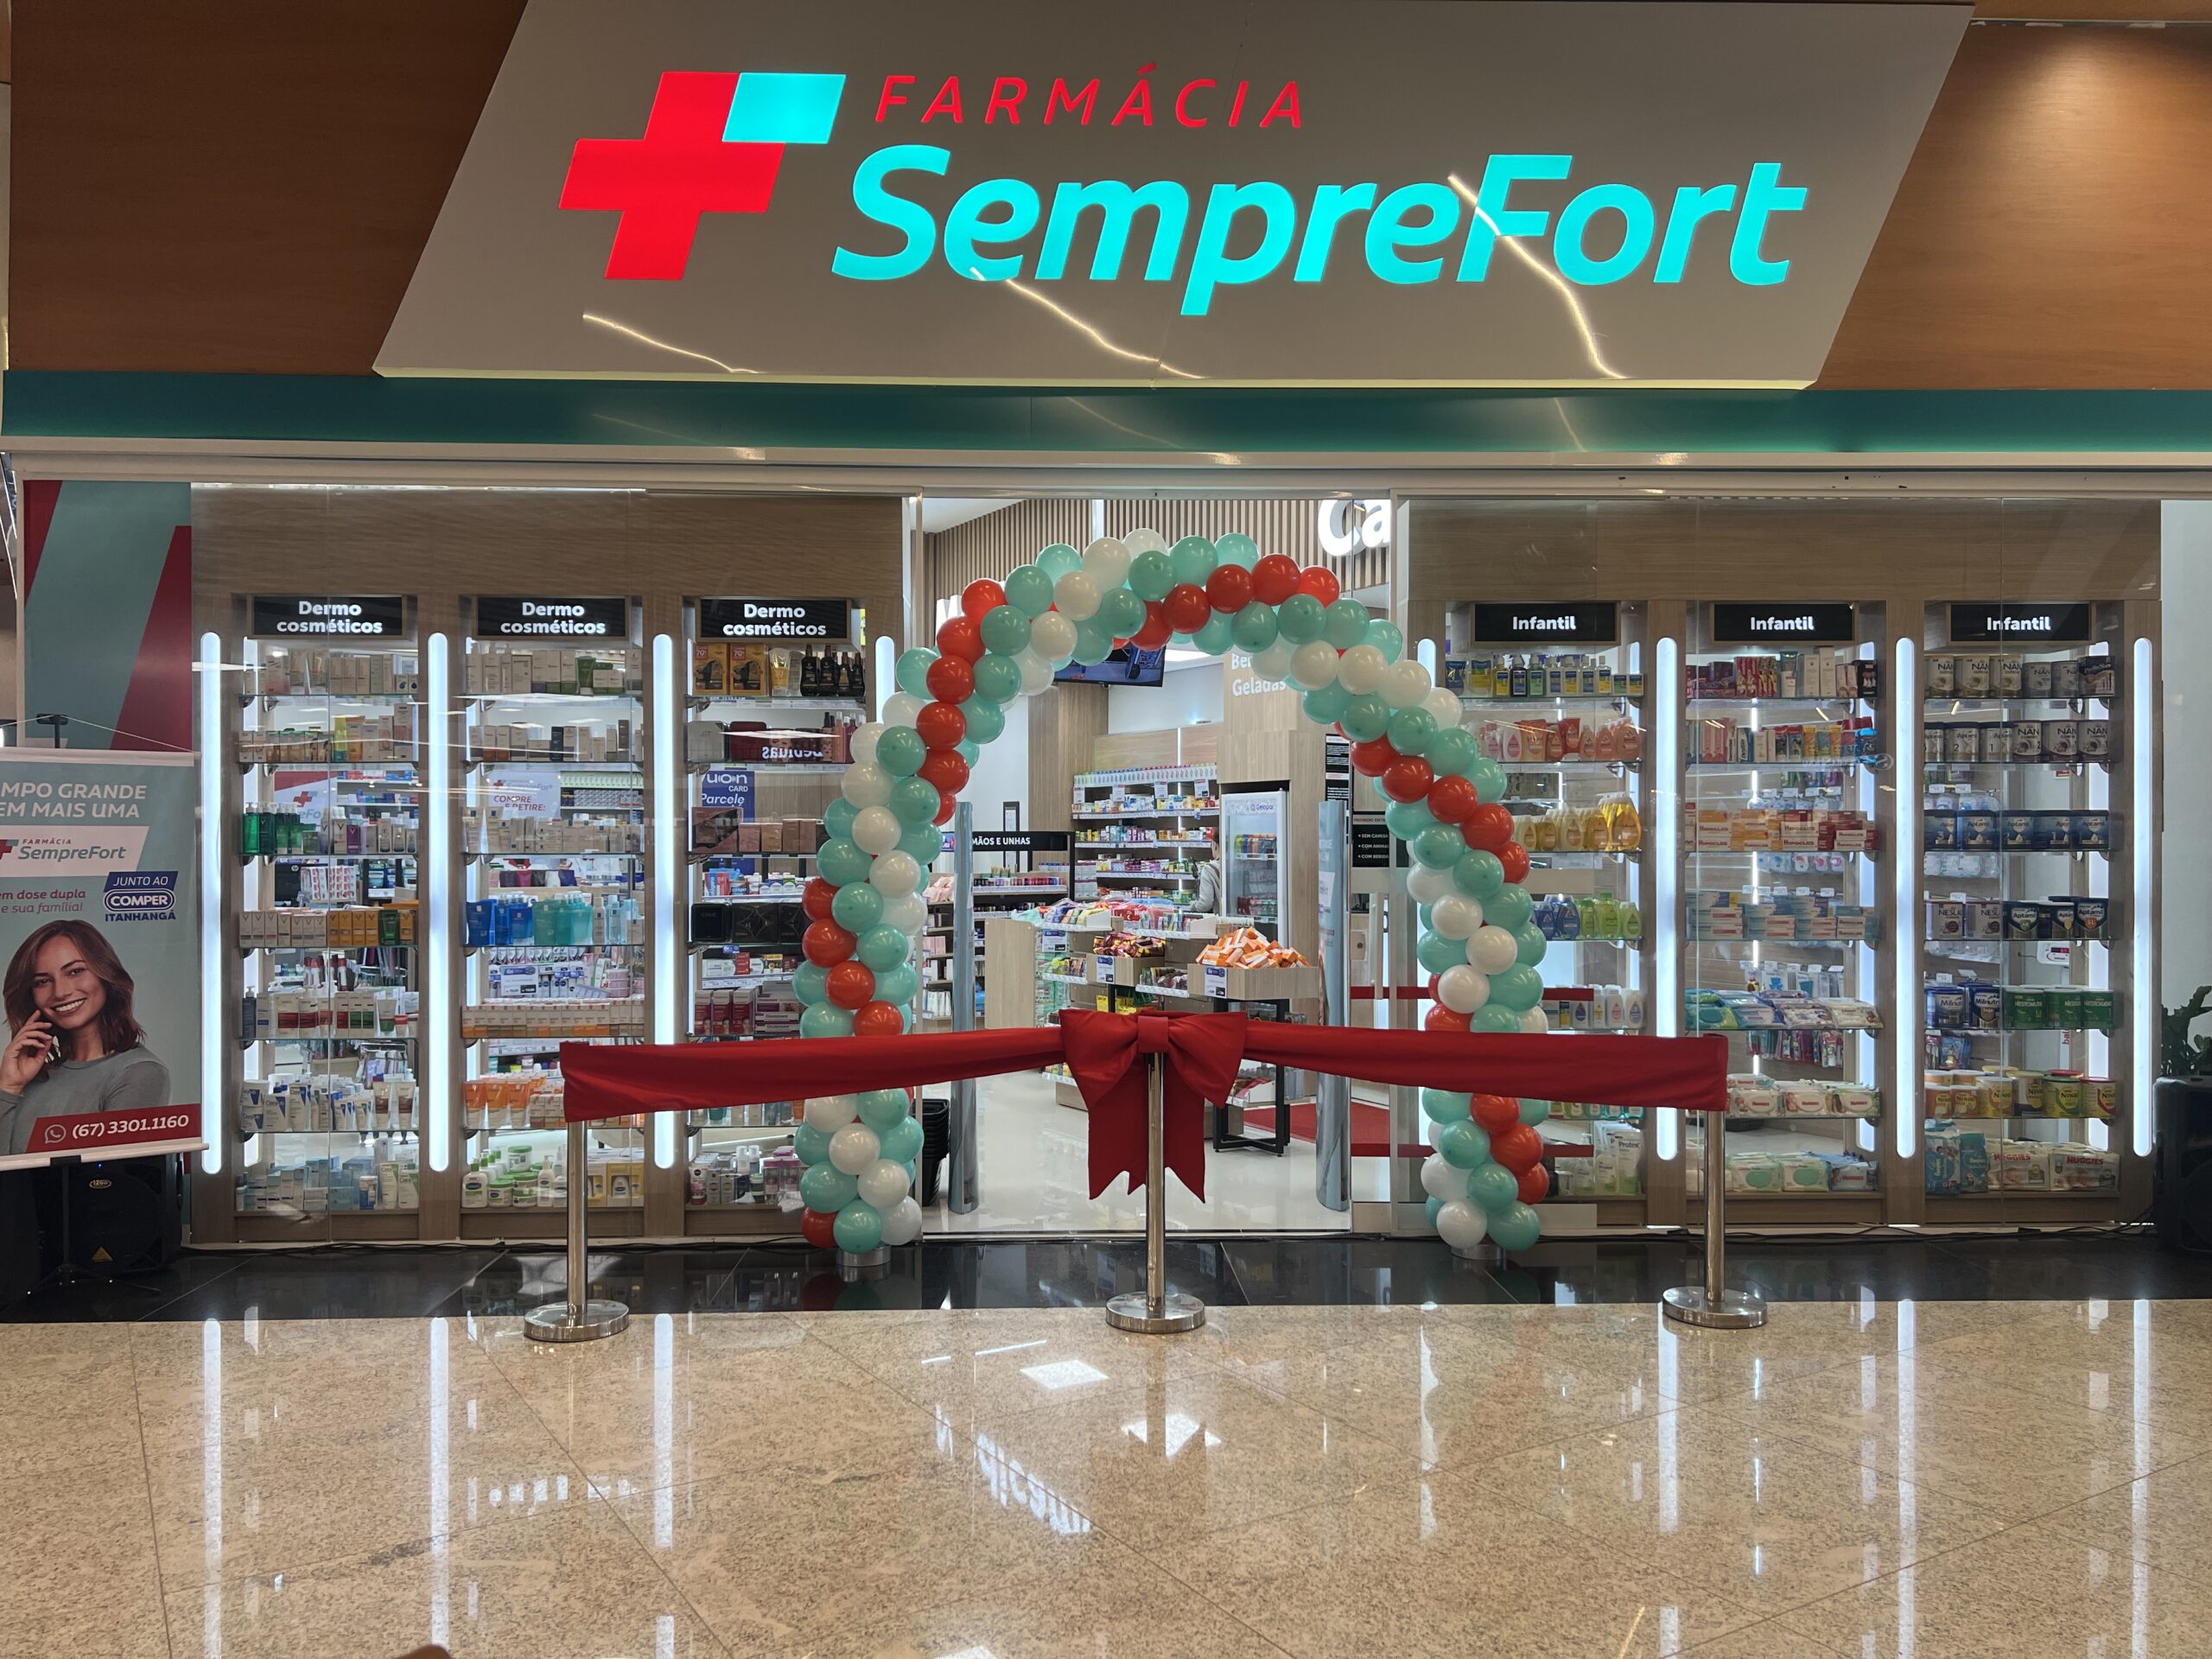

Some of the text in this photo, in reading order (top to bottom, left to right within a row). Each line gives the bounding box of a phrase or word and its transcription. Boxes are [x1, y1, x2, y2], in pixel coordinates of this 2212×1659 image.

[874, 62, 1303, 129] FARMÁCIA
[831, 144, 1808, 315] SempreFort
[298, 601, 362, 616] Dermo
[521, 601, 585, 617] Dermo
[744, 603, 805, 618] Dermo
[276, 618, 383, 633] cosméticos
[500, 619, 606, 634] cosméticos
[722, 621, 827, 636] cosméticos
[1512, 615, 1577, 631] Infantil
[1751, 615, 1815, 631] Infantil
[1986, 616, 2051, 631] Infantil
[58, 783, 147, 799] GRANDE
[31, 803, 86, 817] MAIS
[92, 803, 140, 818] UMA
[972, 836, 995, 846] MÃOS
[1002, 836, 1031, 845] UNHAS
[18, 846, 127, 862] SempreFort
[113, 876, 168, 887] JUNTO AO
[0, 888, 86, 901] m dose dupla
[110, 894, 168, 907] COMPER
[11, 905, 35, 913] sua
[105, 911, 176, 922] ITANHANGÁ
[72, 1115, 189, 1139] (67) 3301.1160
[2067, 1156, 2103, 1165] HUGGIES
